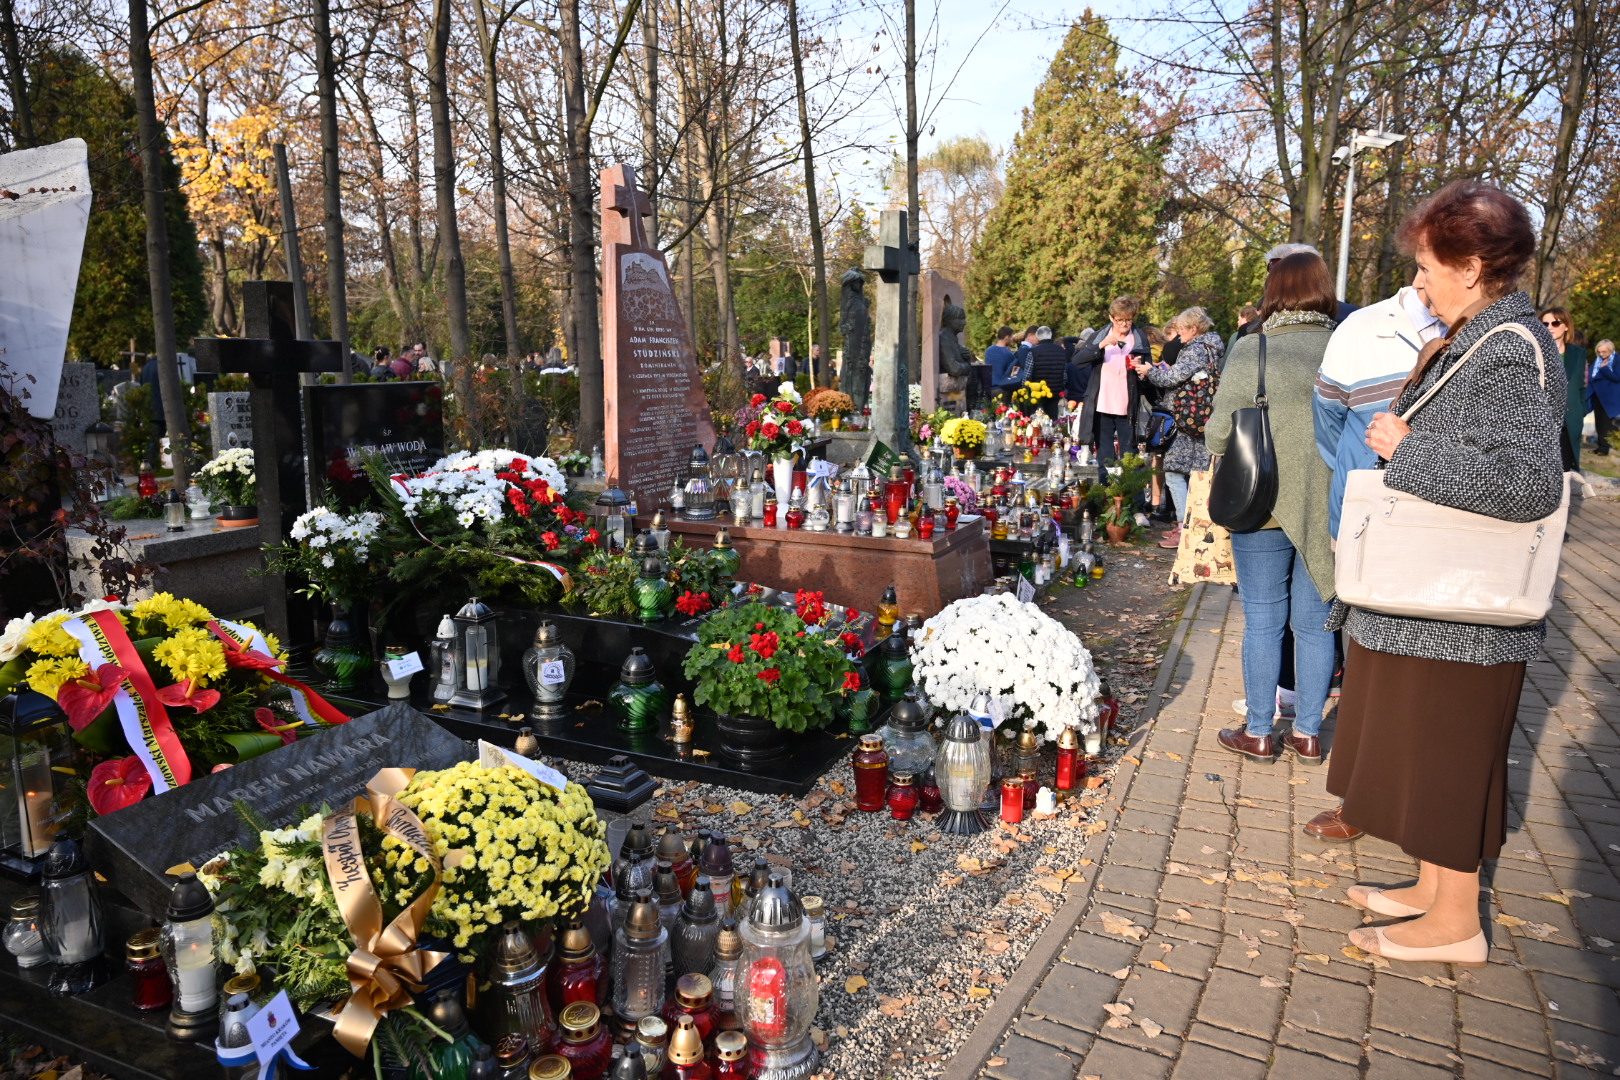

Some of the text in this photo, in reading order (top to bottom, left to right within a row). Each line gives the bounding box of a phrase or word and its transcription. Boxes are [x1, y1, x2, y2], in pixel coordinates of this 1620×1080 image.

[630, 336, 679, 345] ADAM FRANCISZEK
[633, 348, 680, 358] STUDZIŃSKI
[396, 440, 428, 453] WODA
[128, 690, 160, 748] Marszałek
[151, 751, 178, 789] złowski
[183, 732, 392, 824] MAREK NAWARA
[261, 792, 302, 814] WIETNIA
